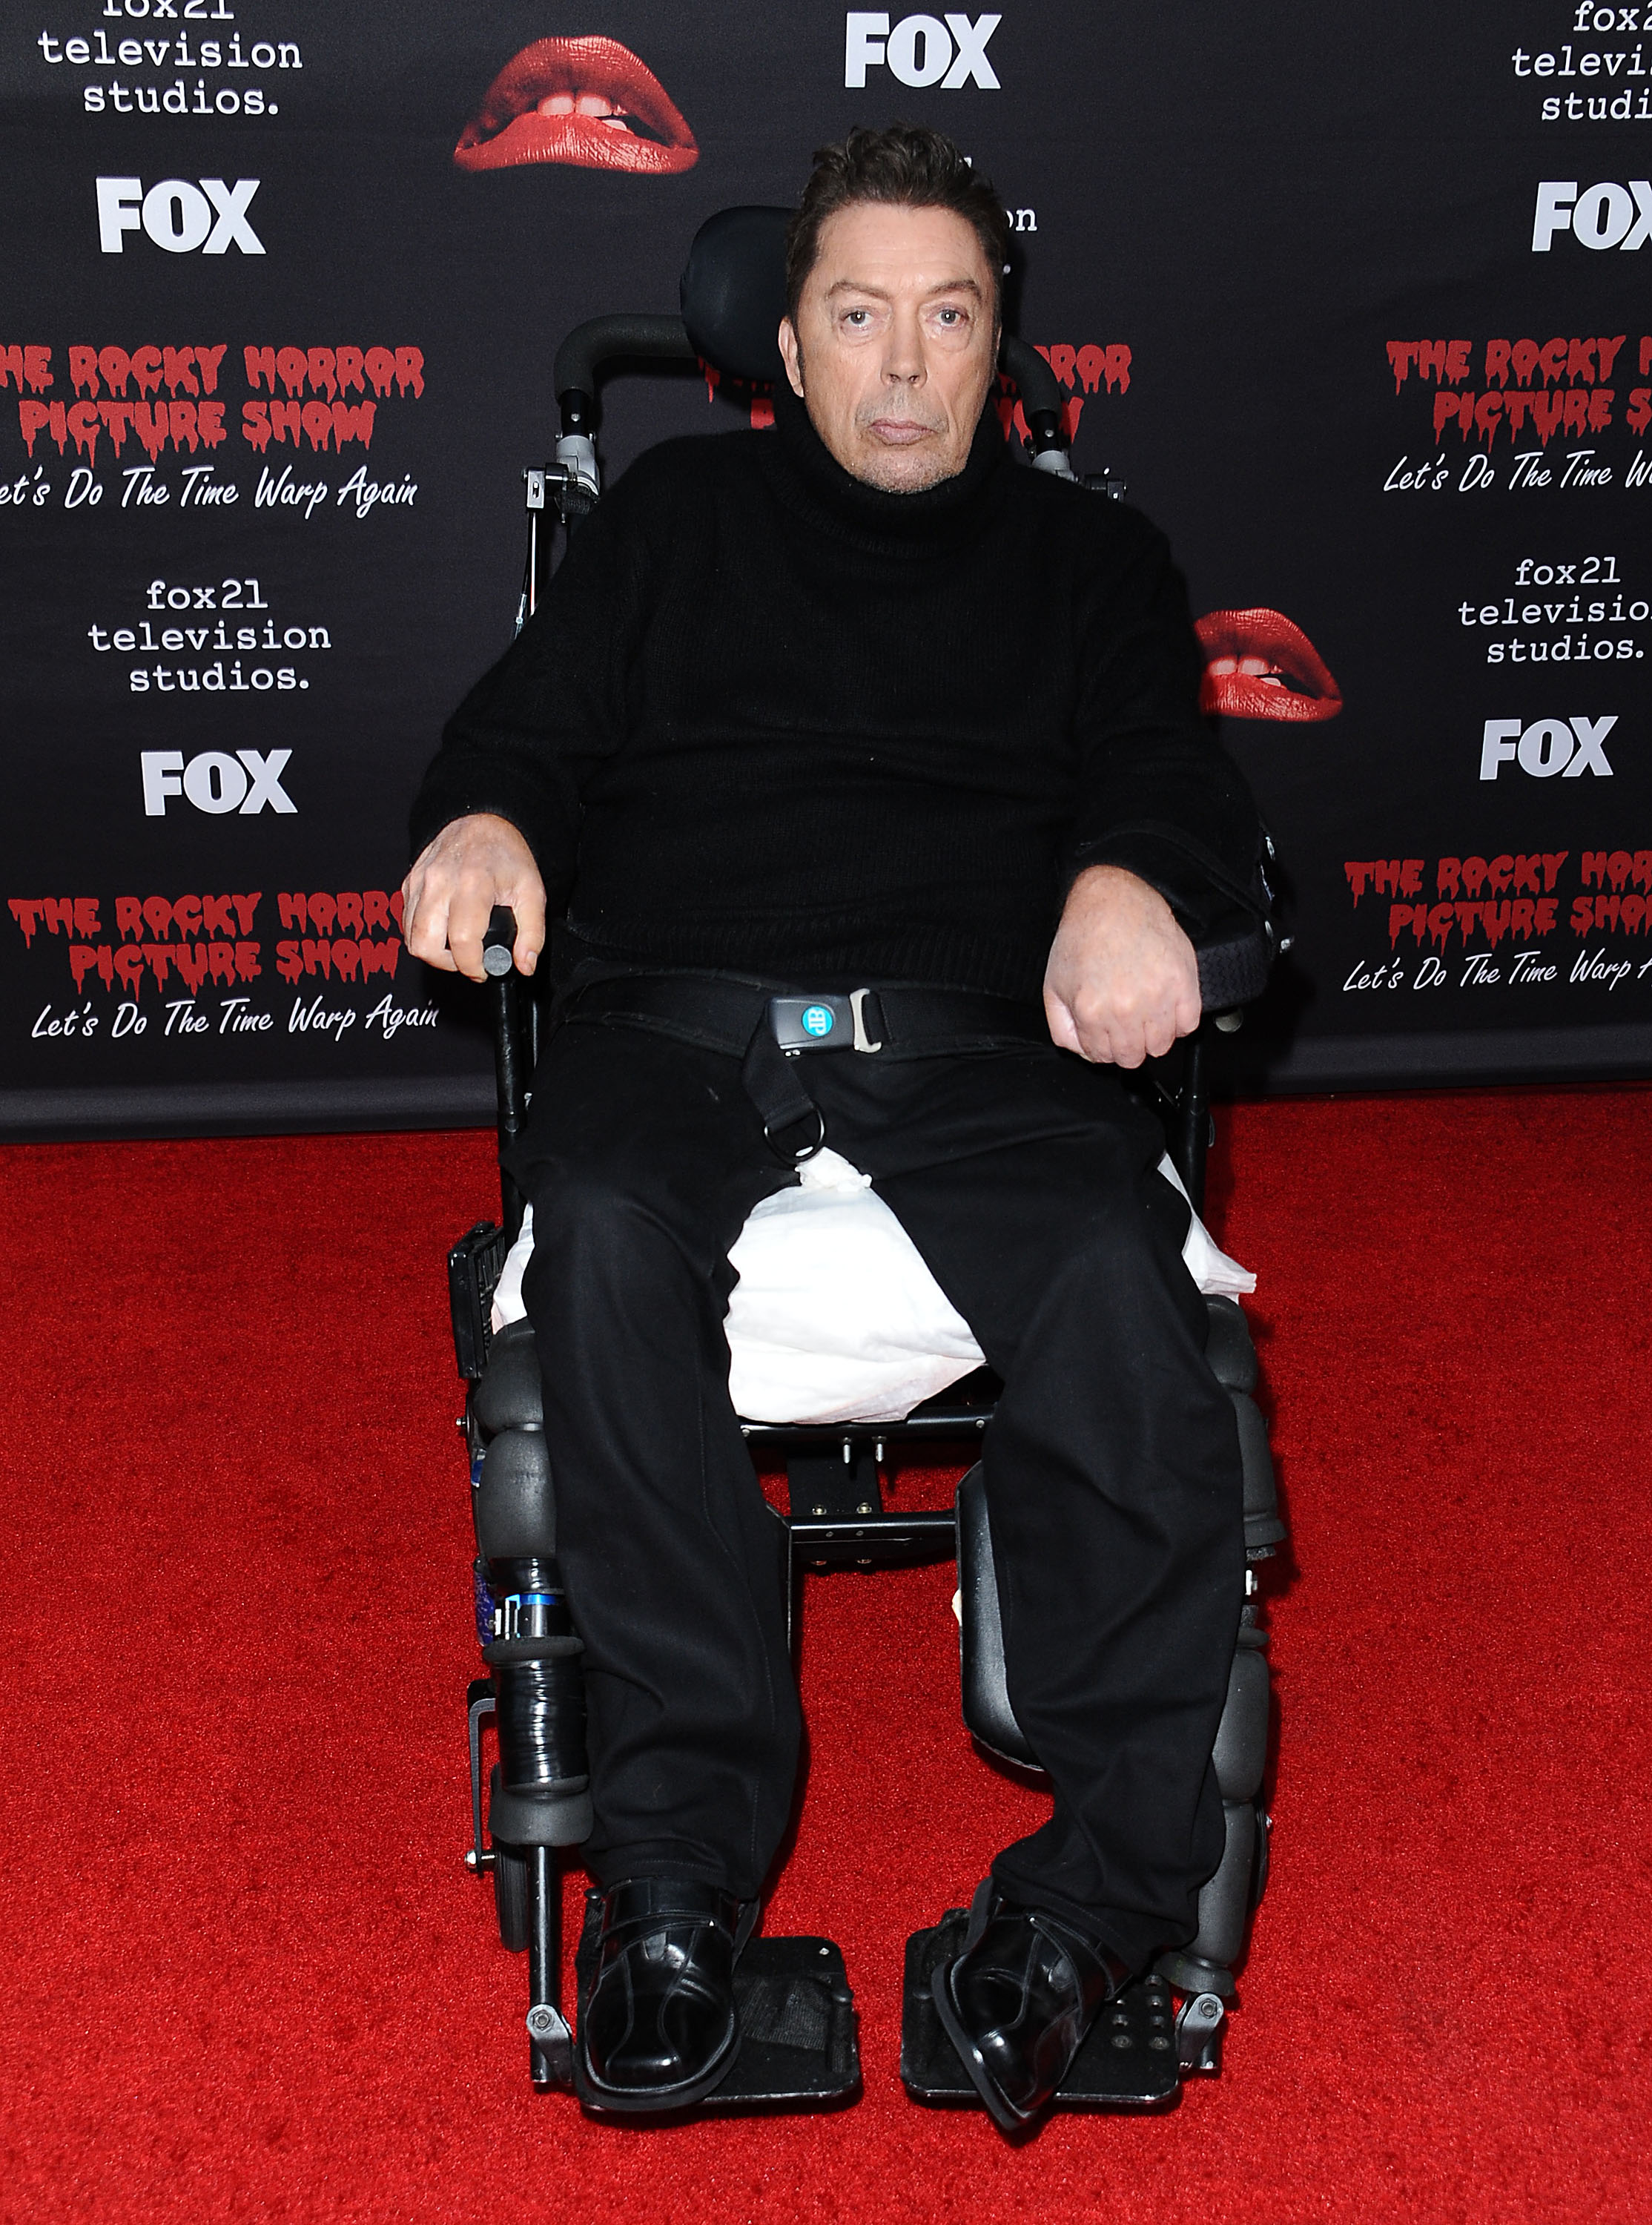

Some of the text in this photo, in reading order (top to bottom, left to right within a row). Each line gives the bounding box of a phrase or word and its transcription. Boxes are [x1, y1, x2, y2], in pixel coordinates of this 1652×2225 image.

[102, 0, 235, 20] fox21
[37, 29, 303, 68] television
[845, 11, 1002, 90] FOX
[1511, 43, 1652, 77] televi
[84, 78, 279, 115] studios.
[95, 176, 267, 254] FOX
[67, 343, 228, 401] ROCKY
[242, 345, 426, 403] HORROR
[1032, 343, 1132, 395] ROR
[1386, 339, 1473, 395] THE
[1484, 334, 1627, 389] ROCKY
[18, 399, 377, 469] PICTURE SHOW
[1433, 388, 1616, 454] PICTURE
[64, 468, 103, 509] Do
[121, 466, 171, 508] The
[180, 465, 239, 507] Time
[254, 464, 328, 520] Warp
[337, 464, 418, 518] Again
[1383, 452, 1450, 492] Let's
[1458, 453, 1495, 492] Do
[1508, 451, 1553, 490] The
[1559, 449, 1613, 489] Time
[146, 578, 268, 610] fox21
[1514, 556, 1621, 586] fox21
[87, 619, 331, 651] television
[1458, 593, 1652, 626] televisio
[1487, 633, 1644, 663] studios.
[129, 660, 309, 692] studios.
[1479, 715, 1619, 781] FOX
[140, 748, 299, 817] FOX
[1344, 859, 1425, 909] THE
[1436, 850, 1569, 900] ROCKY
[7, 897, 102, 949] THE
[114, 891, 262, 943] ROCKY
[1389, 894, 1652, 955] PICTURE SHO
[68, 936, 402, 1003] PICTURE SHOW
[1342, 957, 1404, 992] Let's
[1413, 957, 1447, 990] Do
[1459, 953, 1501, 987] The
[1508, 950, 1558, 985] Time
[1569, 947, 1632, 992] Warp
[31, 993, 439, 1042] Let's Do The Time Warp Again
